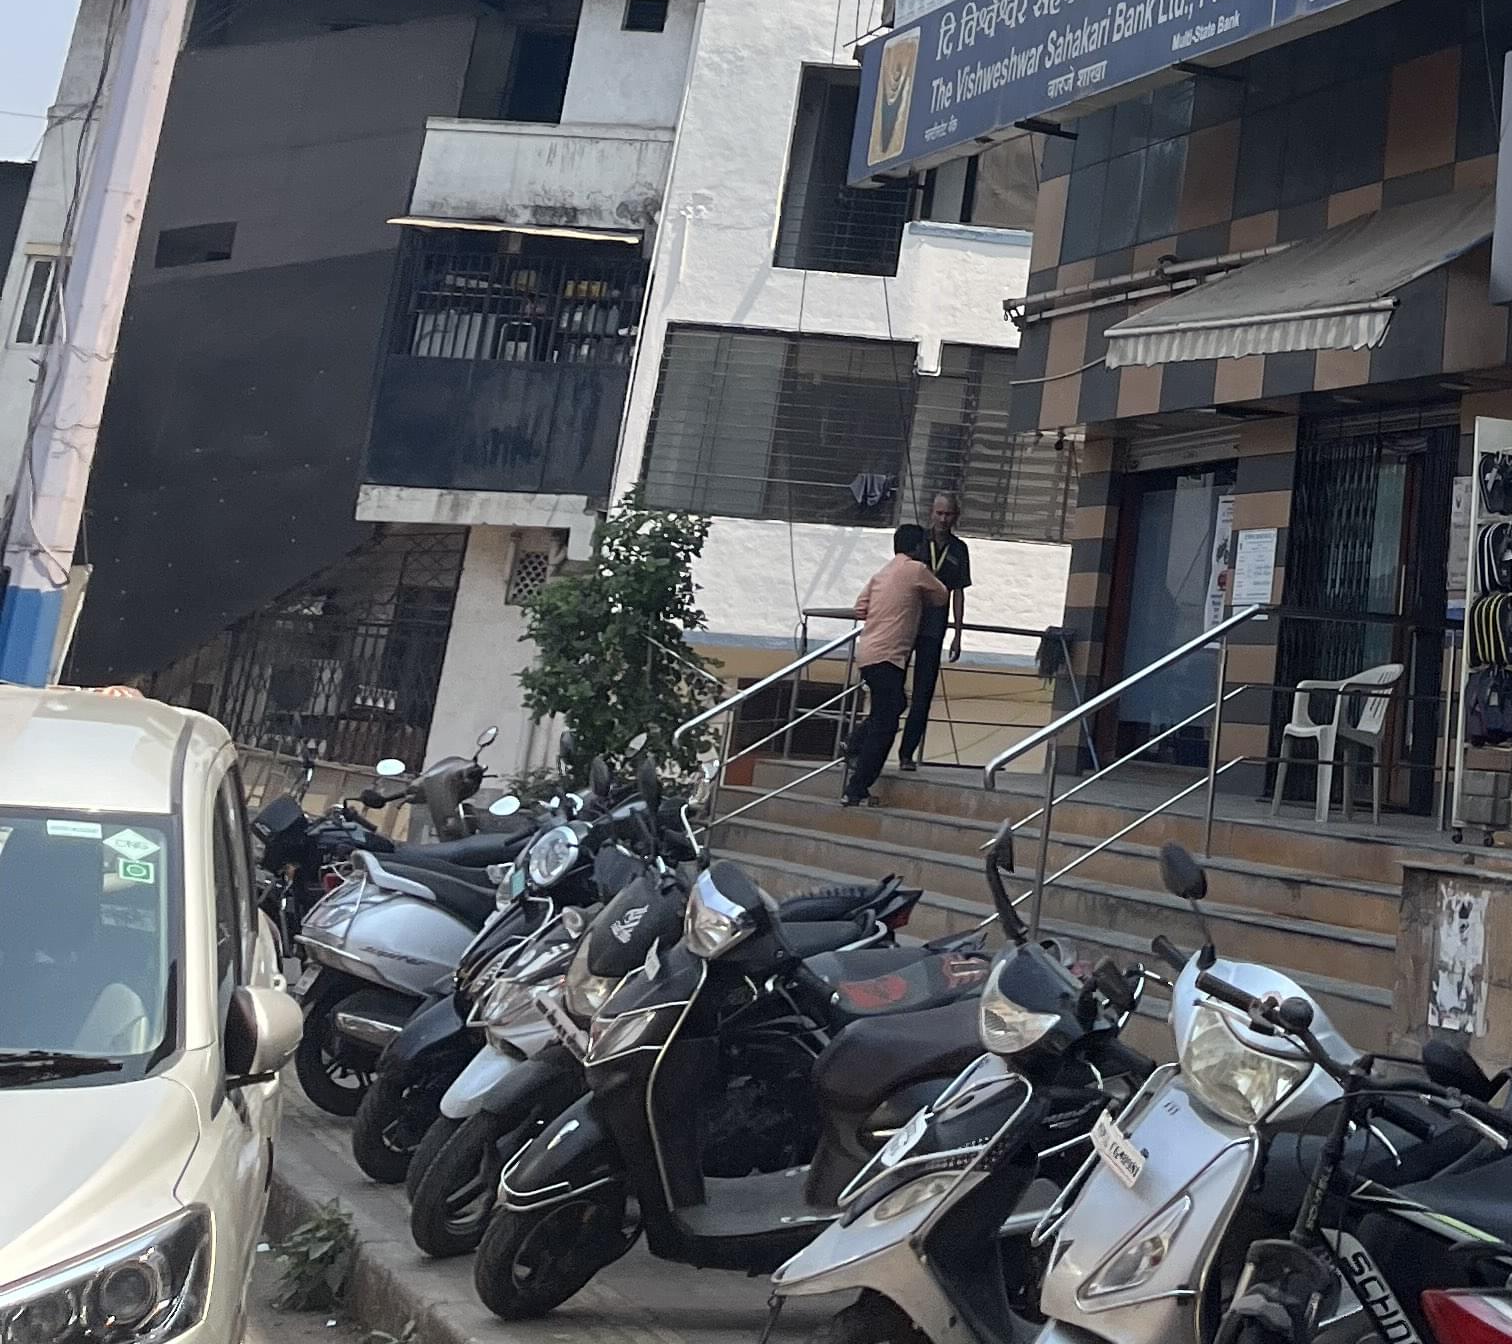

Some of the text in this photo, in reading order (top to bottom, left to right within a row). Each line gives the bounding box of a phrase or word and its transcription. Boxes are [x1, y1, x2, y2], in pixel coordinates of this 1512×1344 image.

[935, 11, 957, 62] दि
[1216, 10, 1241, 37] Bank
[929, 76, 952, 115] The
[954, 41, 1044, 105] Vishweshwar
[1044, 9, 1112, 70] Sahakari
[1047, 58, 1108, 100] वारजे शाखा
